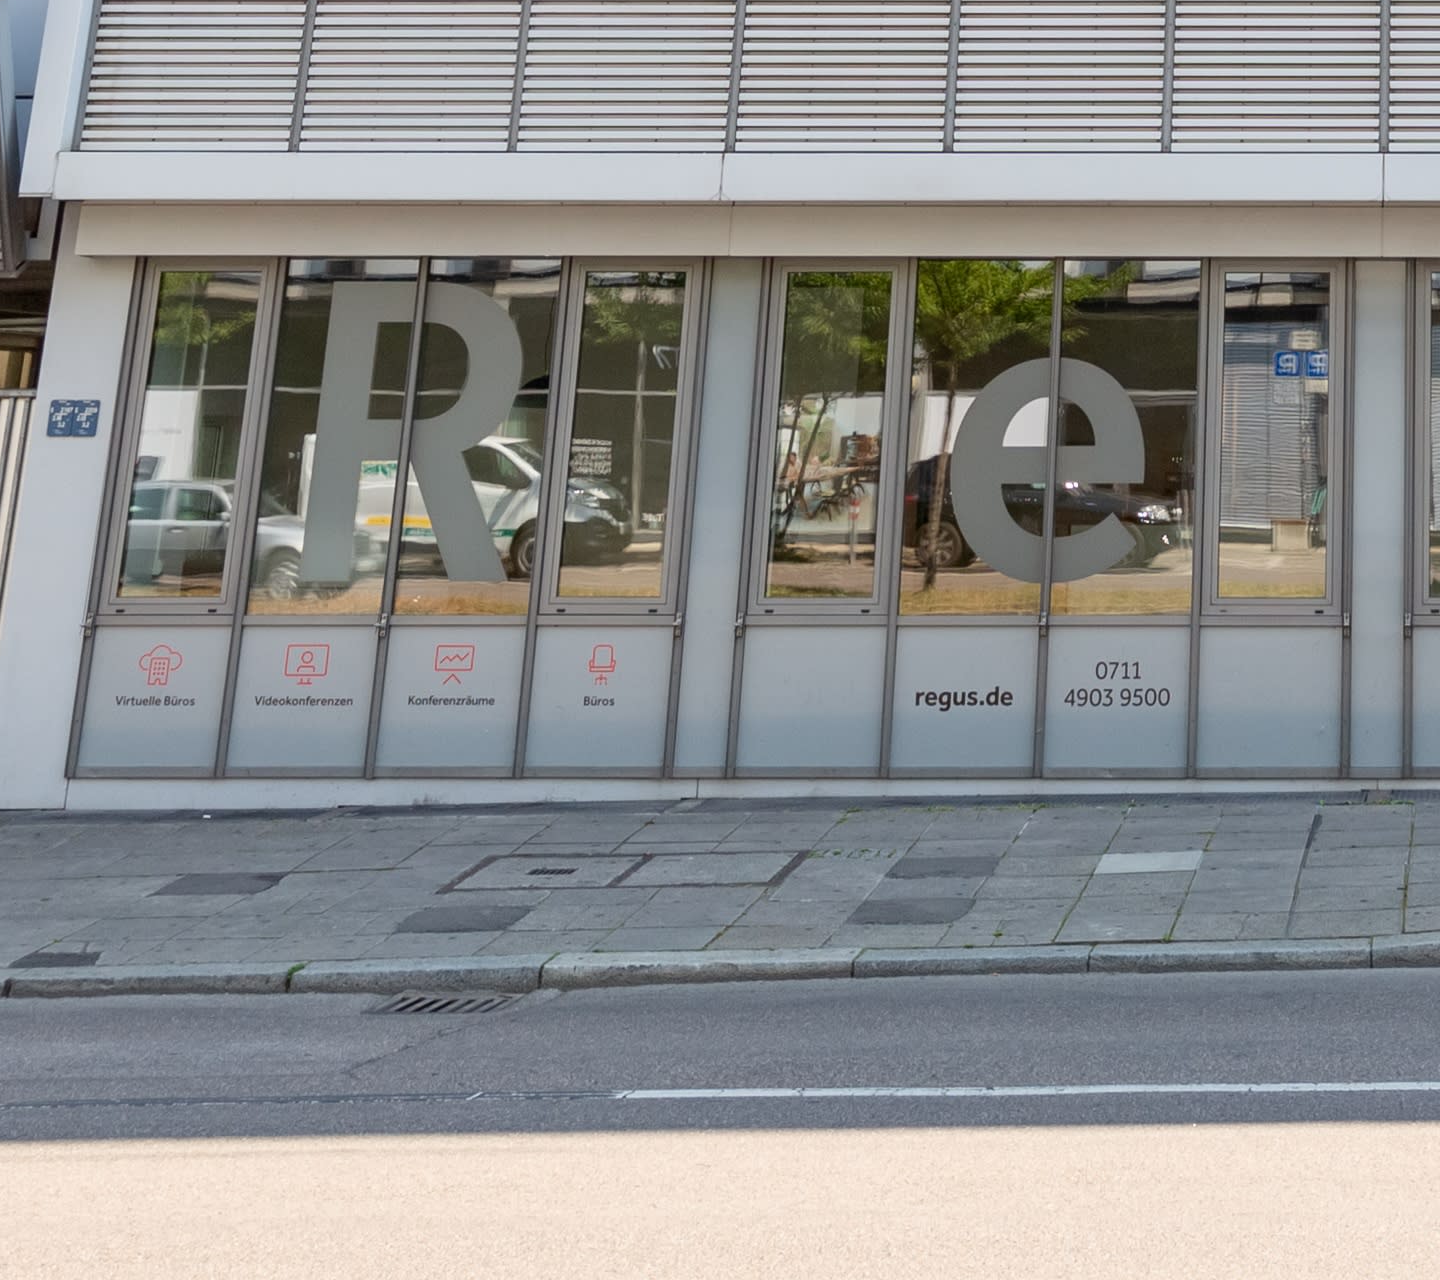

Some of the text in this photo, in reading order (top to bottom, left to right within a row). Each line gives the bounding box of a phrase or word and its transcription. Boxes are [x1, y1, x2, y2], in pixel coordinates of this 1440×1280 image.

[1095, 661, 1141, 680] 0711
[115, 695, 196, 707] Virtuelle Büros
[254, 695, 353, 707] Videokonferenzen
[407, 695, 495, 707] Konferenzräume
[583, 695, 615, 707] Büros
[915, 686, 1013, 711] regus.de
[1064, 688, 1171, 707] 4903 9500
